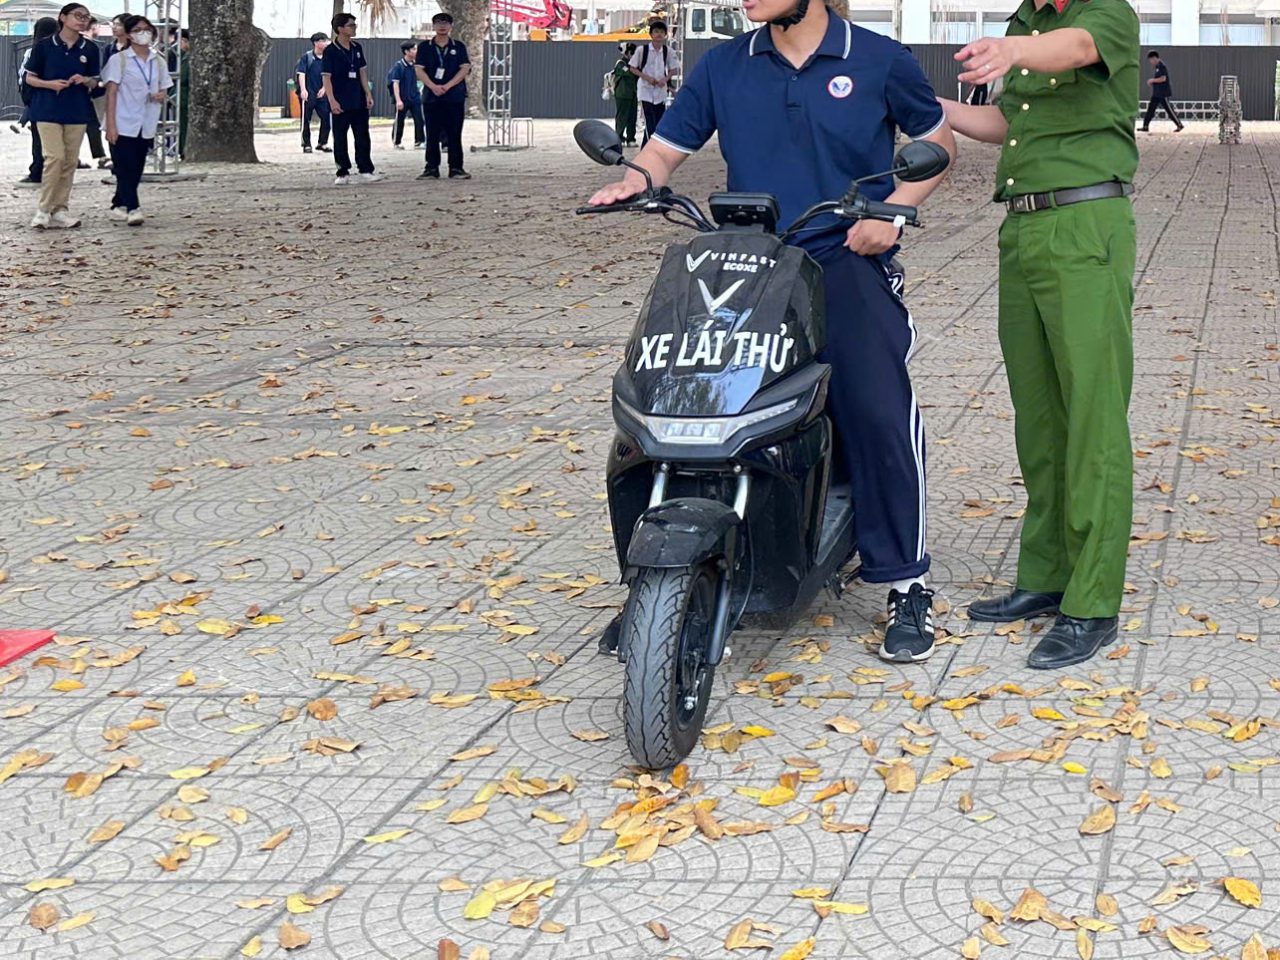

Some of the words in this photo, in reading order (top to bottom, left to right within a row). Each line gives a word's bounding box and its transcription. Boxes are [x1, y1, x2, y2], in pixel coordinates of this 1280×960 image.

[710, 252, 777, 268] VINFAST
[722, 262, 759, 273] ECOXE
[634, 333, 674, 373] XE
[675, 319, 727, 367] LÁI
[733, 322, 795, 374] THỬ
